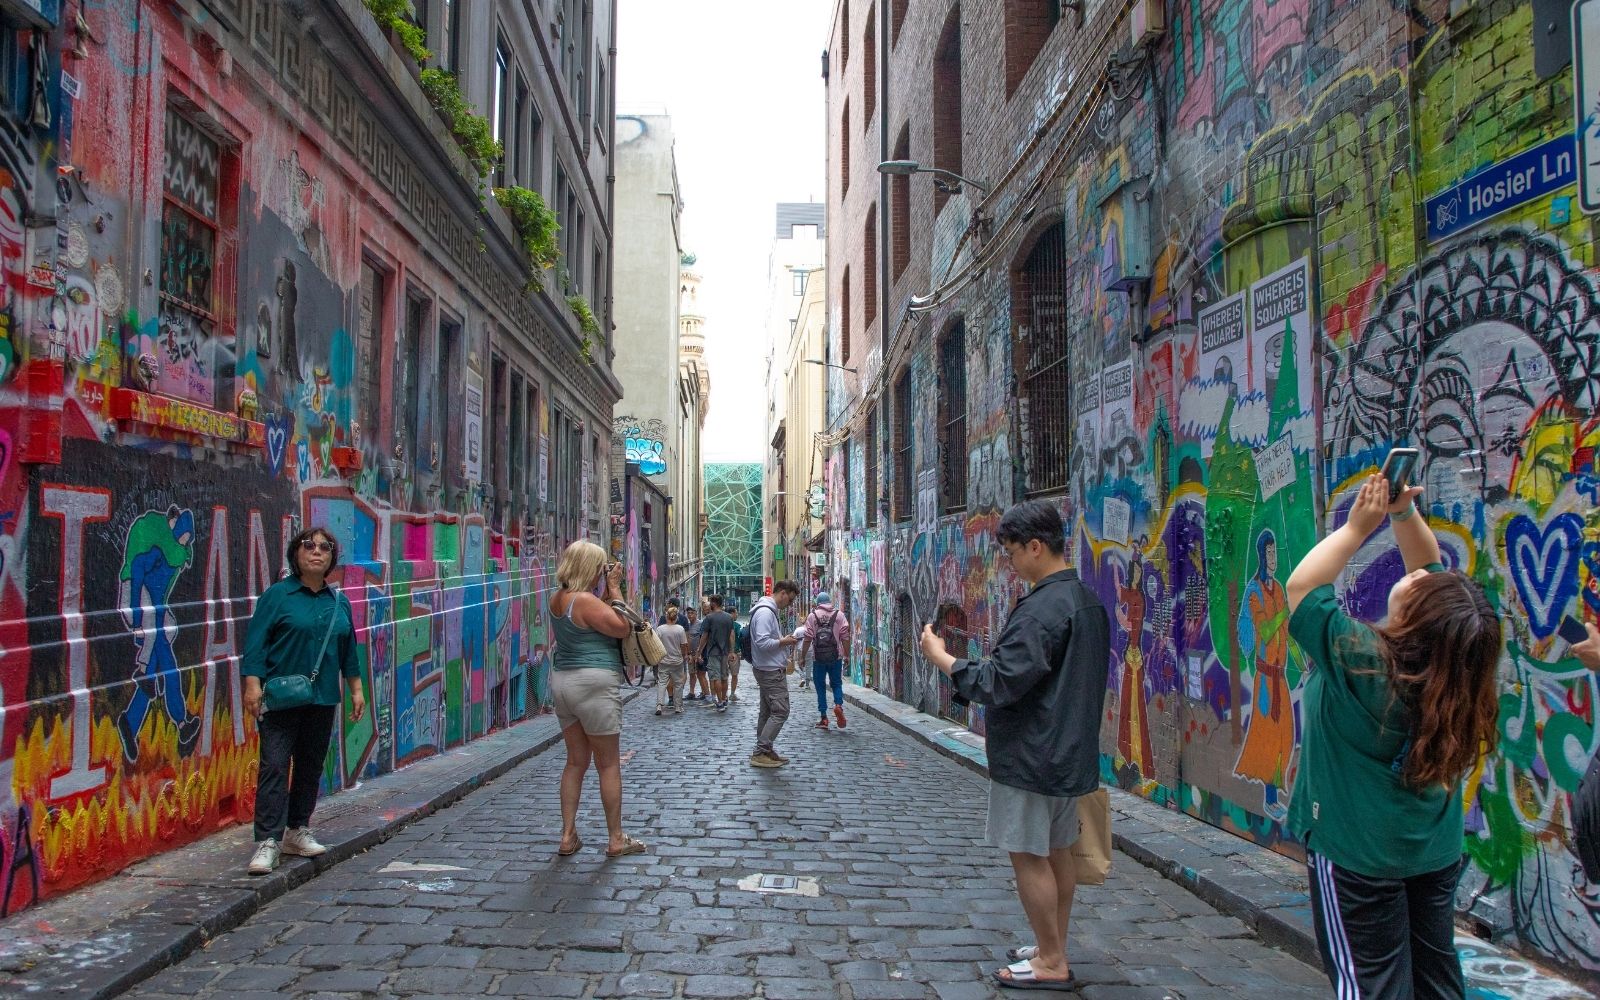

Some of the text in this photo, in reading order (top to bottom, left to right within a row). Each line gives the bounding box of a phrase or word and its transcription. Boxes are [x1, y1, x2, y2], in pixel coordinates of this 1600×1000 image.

[1468, 151, 1571, 216] Hosier Ln
[1255, 270, 1304, 308] WHERE IS
[1202, 307, 1233, 334] WHERE
[1256, 291, 1305, 327] SQUARE?
[1203, 321, 1242, 351] SQUARE?
